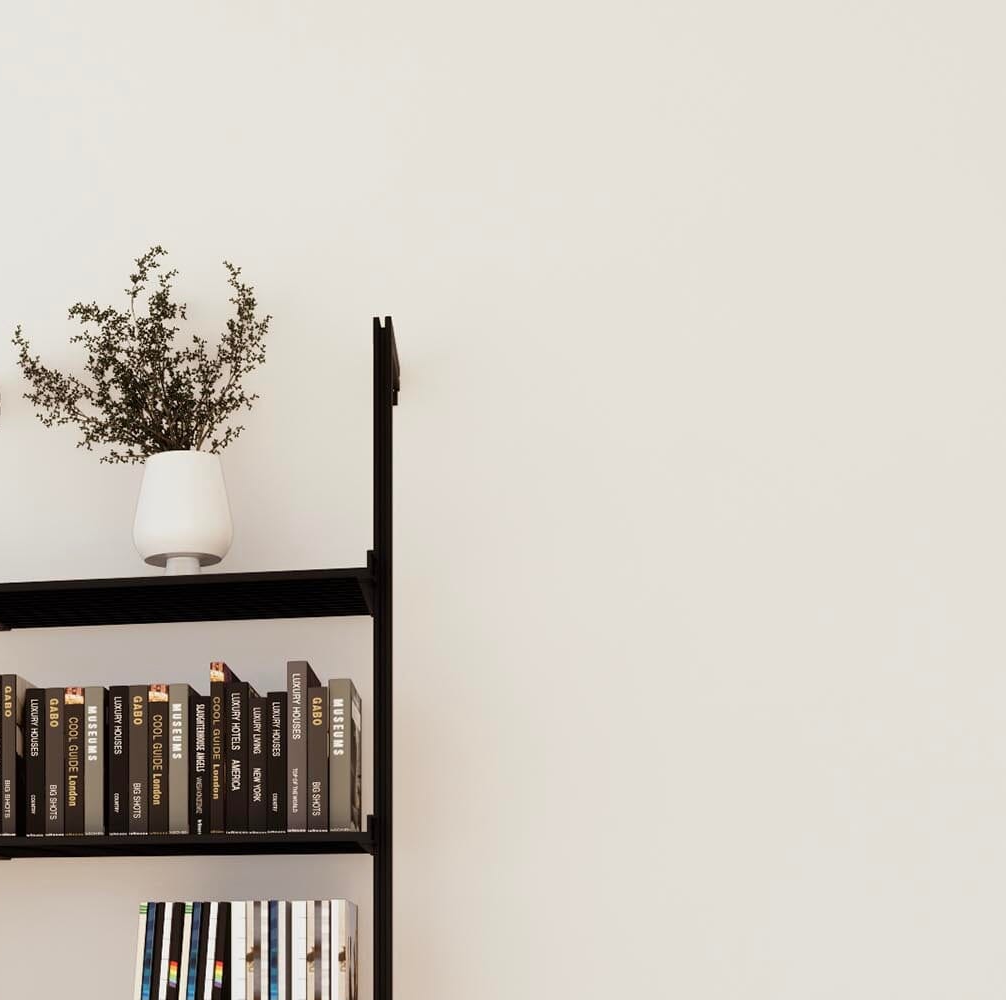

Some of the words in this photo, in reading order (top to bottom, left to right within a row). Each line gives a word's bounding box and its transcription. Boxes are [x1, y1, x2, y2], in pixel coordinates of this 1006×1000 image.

[4, 686, 12, 717] GABO
[292, 673, 300, 705] LUXURY
[30, 699, 38, 726] LUXURY
[49, 698, 59, 728] GABO
[114, 696, 122, 723] LUXURY
[133, 696, 143, 725] GABO
[213, 696, 221, 725] COOL
[231, 693, 240, 722] LUXURY
[253, 707, 261, 733] LUXURY
[272, 702, 280, 728] LUXURY
[312, 697, 322, 726] GABO
[68, 717, 78, 742] COOL
[88, 706, 97, 762] MUSEUMS
[152, 715, 162, 740] COOL
[172, 703, 182, 759] MUSEUMS
[231, 723, 240, 750] HOTELS
[292, 707, 301, 739] HOUSES
[333, 698, 344, 756] MUSEUMS
[30, 728, 39, 756] HOUSES
[114, 725, 122, 755] HOUSES
[213, 729, 221, 760] GUIDE
[253, 734, 261, 754] LIVING
[272, 730, 281, 757] HOUSES
[68, 745, 79, 772] GUIDE
[152, 743, 163, 770] GUIDE
[196, 753, 205, 772] ANGELS
[133, 783, 141, 794] BIG
[152, 773, 163, 805] London
[213, 764, 221, 800] London
[231, 760, 240, 791] AMERICA
[253, 768, 261, 783] NEW
[312, 782, 320, 793] BIG
[68, 775, 79, 807] London
[253, 784, 261, 802] YORK
[133, 796, 141, 819] SHOTS
[312, 794, 321, 816] SHOTS
